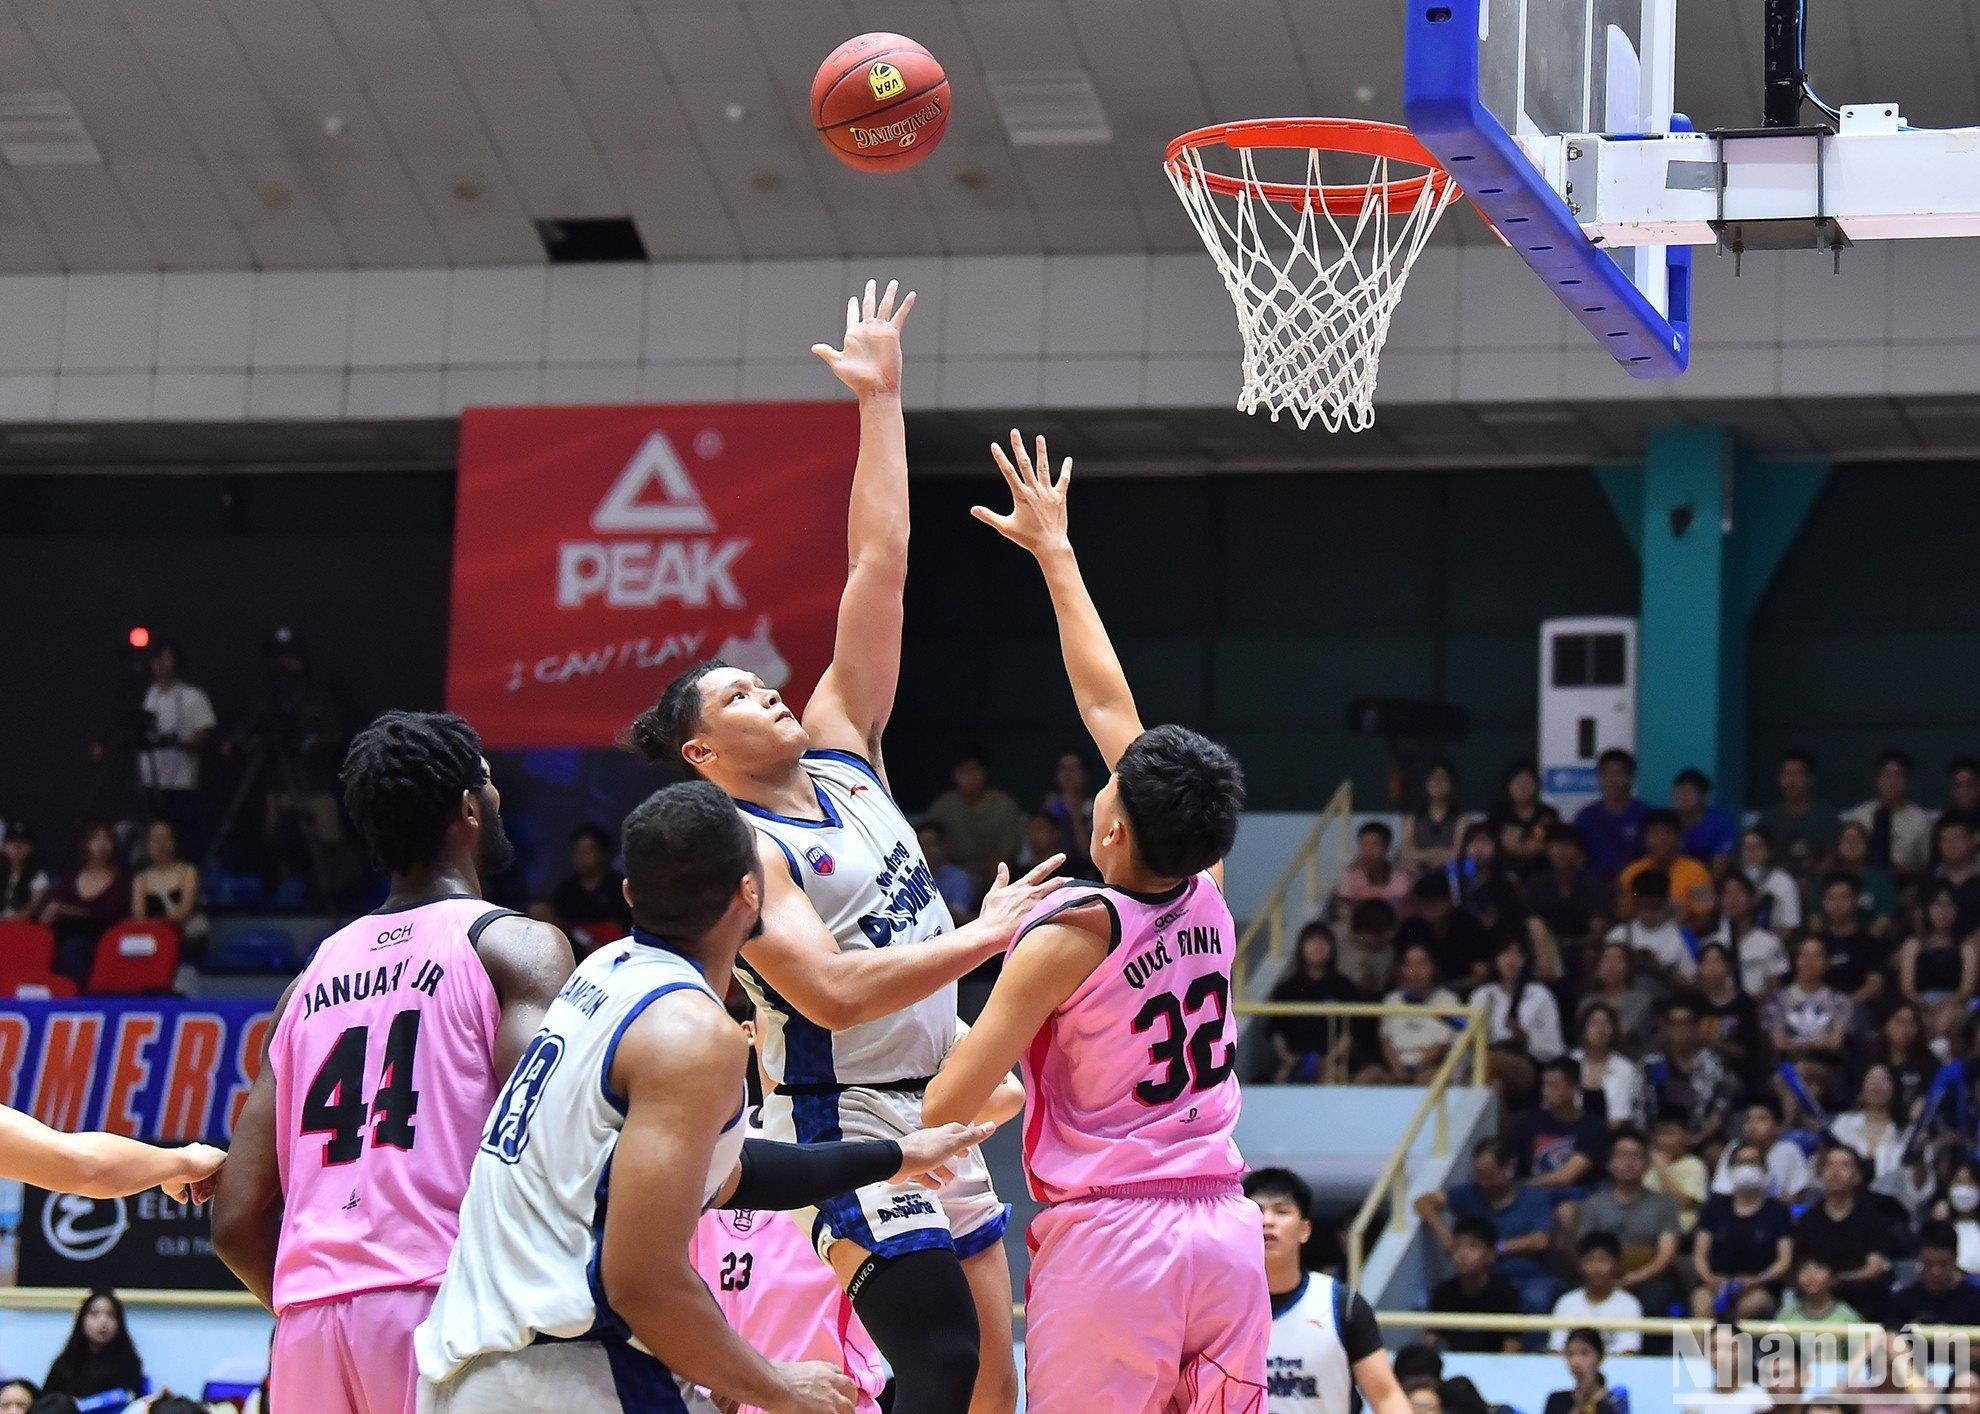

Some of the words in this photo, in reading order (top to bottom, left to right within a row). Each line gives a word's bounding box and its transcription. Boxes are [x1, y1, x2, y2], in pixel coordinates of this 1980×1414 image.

[875, 78, 899, 95] VBA
[853, 95, 942, 149] SPALDING
[555, 537, 751, 610] PEAK
[807, 847, 826, 864] VBA
[377, 922, 414, 944] OCH
[411, 959, 445, 998] JR
[1130, 970, 1236, 1108] 32
[299, 1008, 421, 1168] 44
[720, 1251, 754, 1292] 23
[852, 1262, 875, 1295] SALVEO
